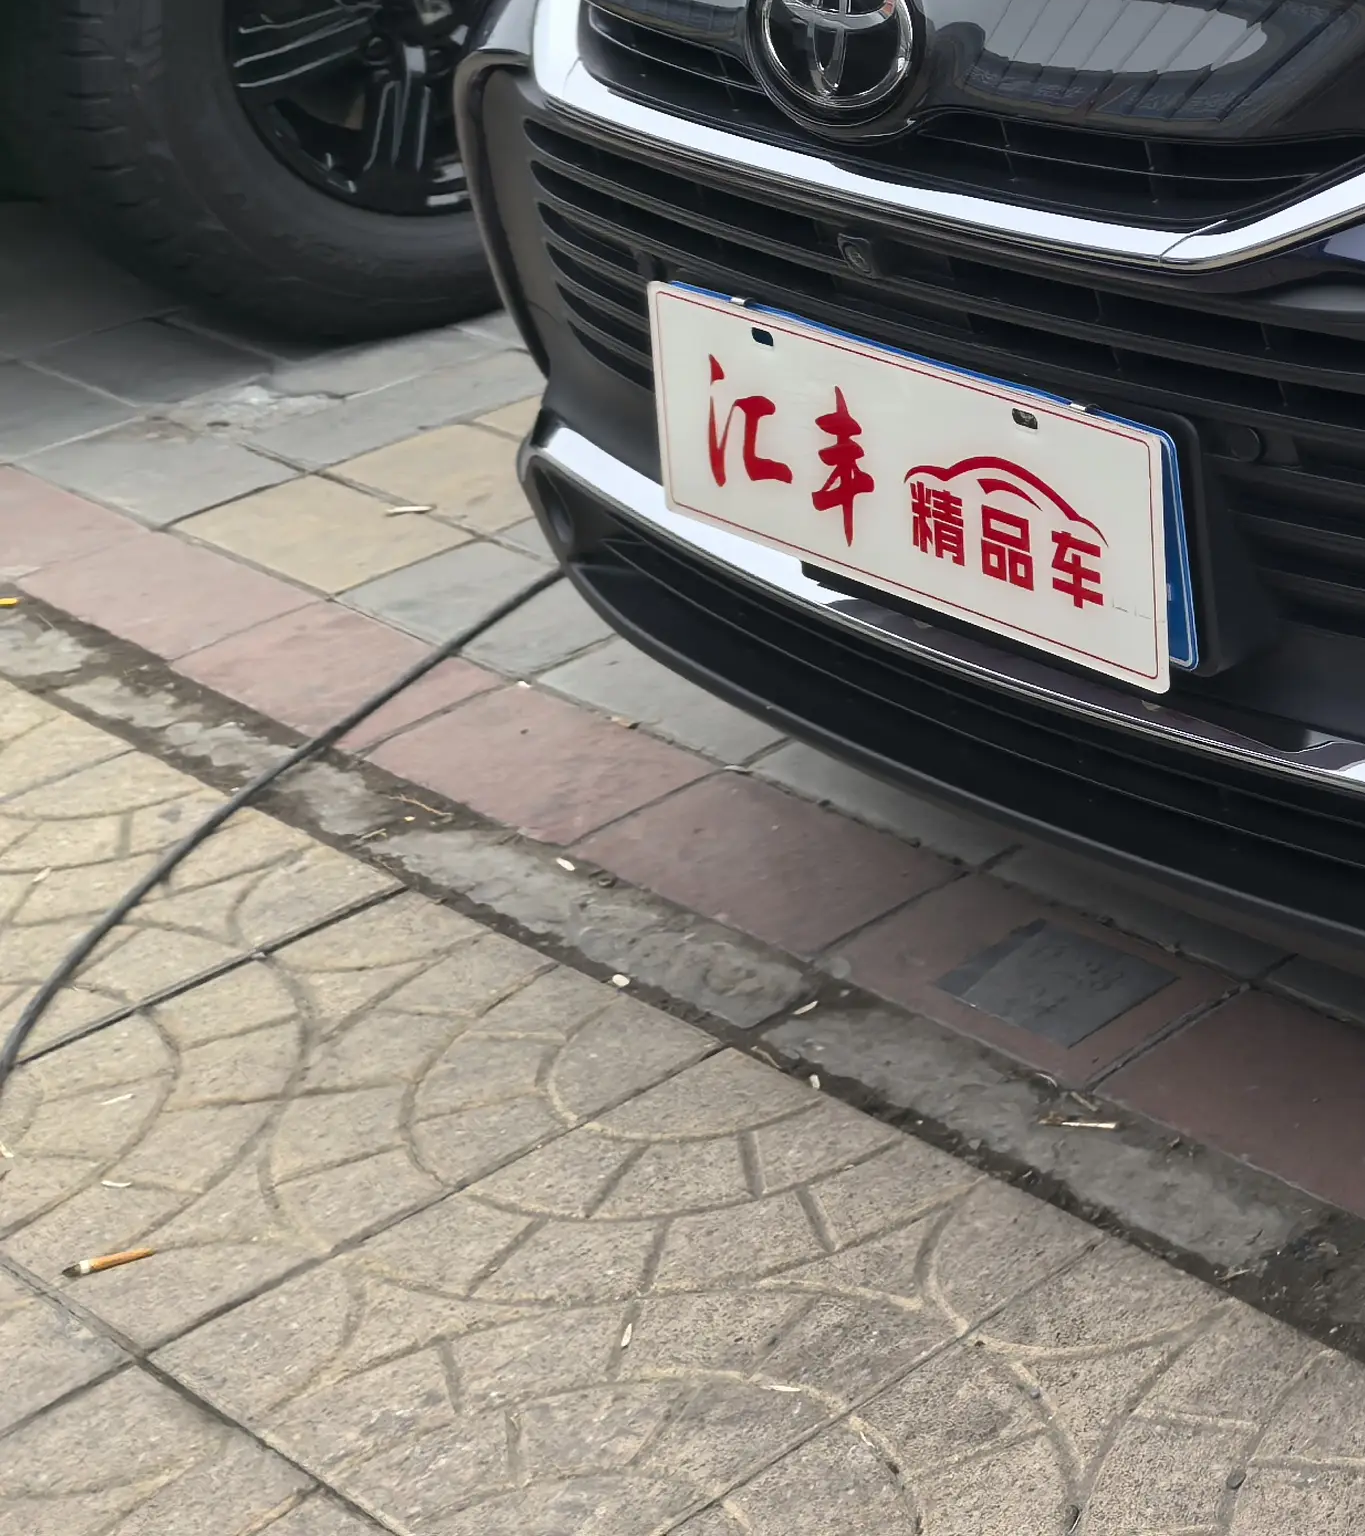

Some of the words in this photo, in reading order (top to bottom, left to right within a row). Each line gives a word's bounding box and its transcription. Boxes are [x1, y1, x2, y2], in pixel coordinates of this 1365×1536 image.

[708, 354, 875, 547] 汇丰
[910, 481, 1104, 609] 精品车
